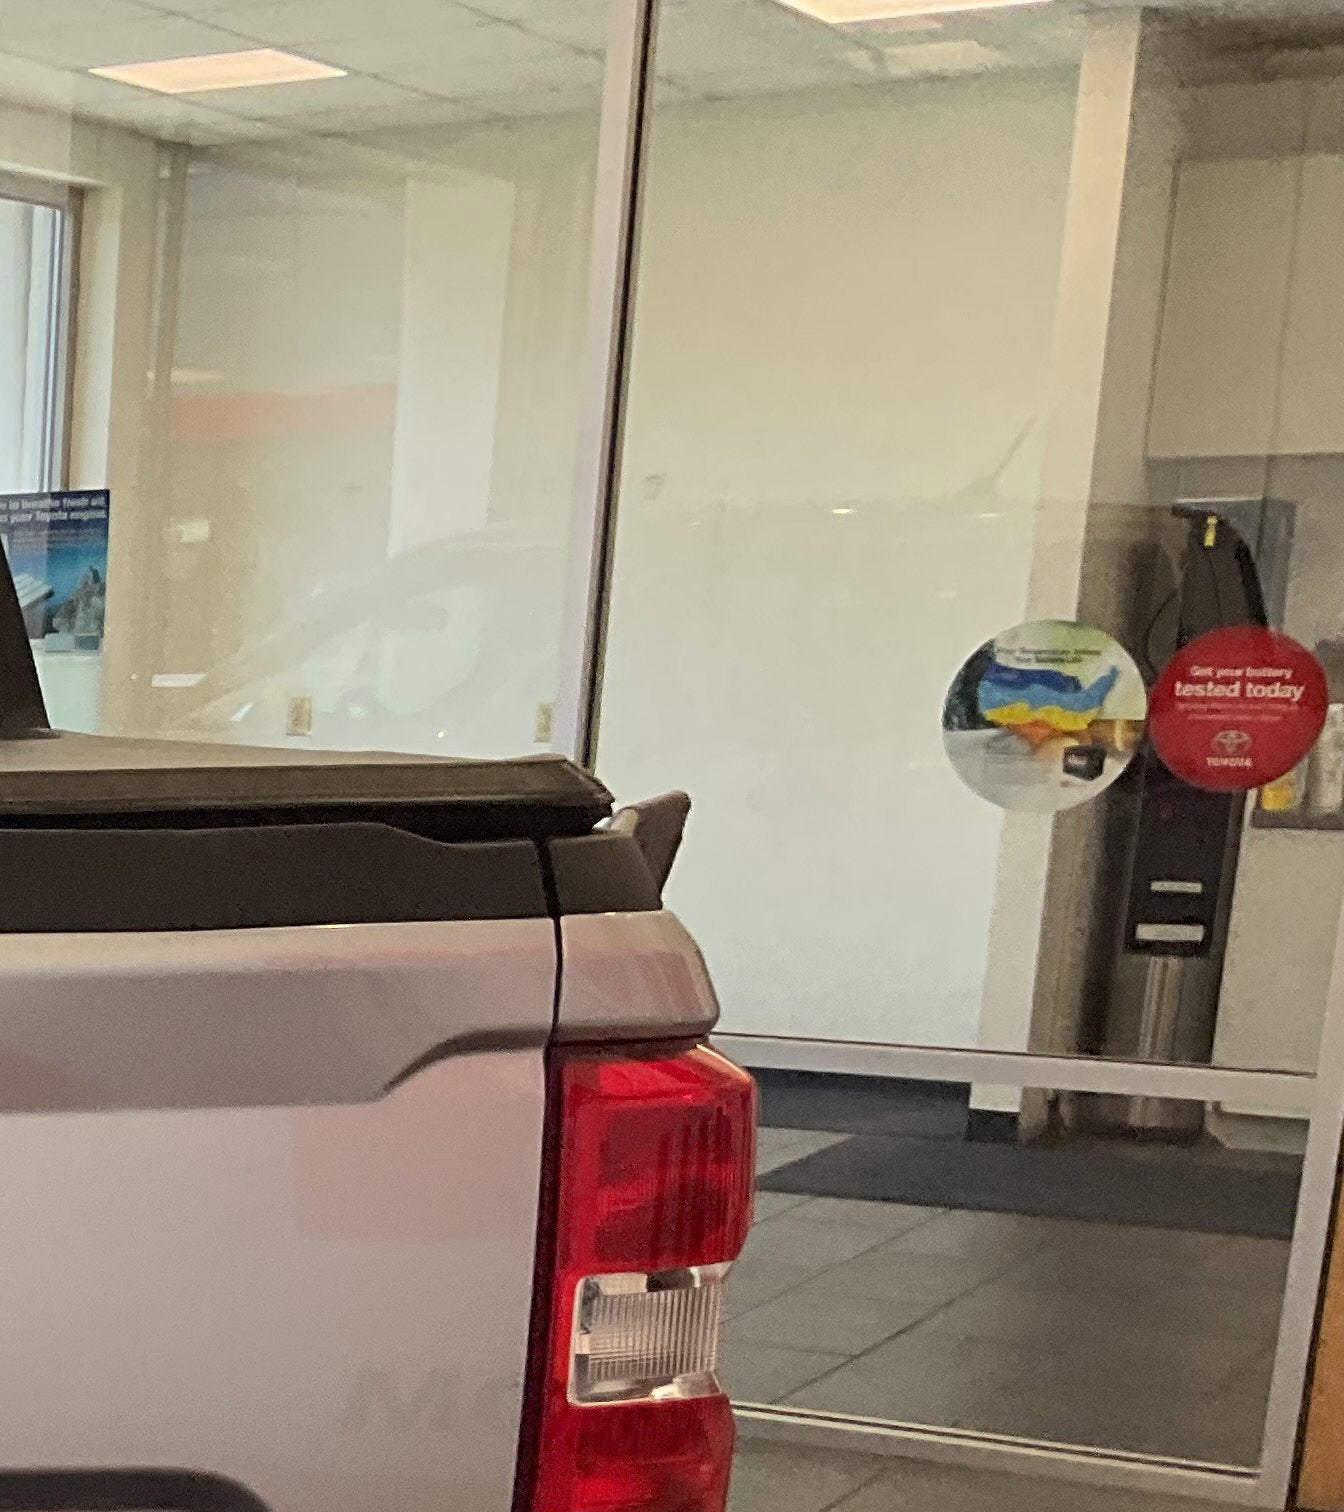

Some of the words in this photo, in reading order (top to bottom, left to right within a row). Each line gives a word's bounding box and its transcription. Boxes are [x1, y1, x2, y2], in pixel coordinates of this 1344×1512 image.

[34, 510, 69, 523] Toyota
[1215, 667, 1244, 679] your
[1245, 666, 1293, 680] battery
[1174, 680, 1241, 697] tested
[1245, 681, 1305, 703] today
